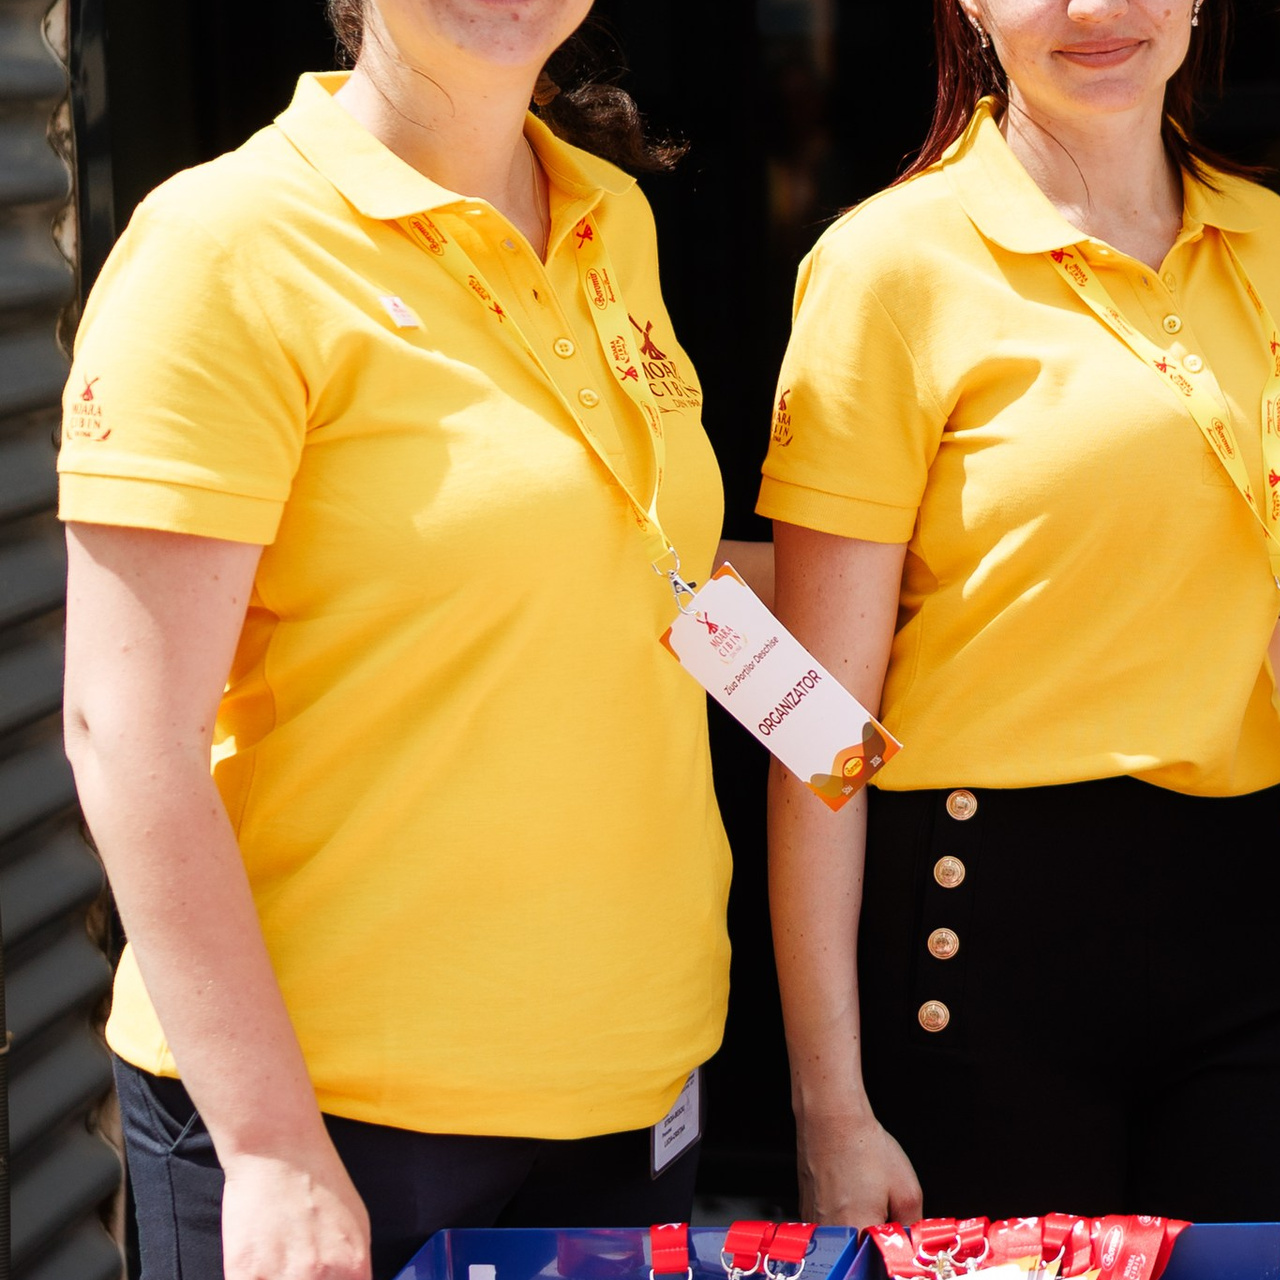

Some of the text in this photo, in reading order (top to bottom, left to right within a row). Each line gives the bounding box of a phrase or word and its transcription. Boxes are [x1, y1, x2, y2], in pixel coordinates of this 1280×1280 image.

[588, 272, 606, 307] Boromir
[642, 362, 685, 383] OAR
[1213, 420, 1234, 456] Boromir
[710, 624, 734, 648] MOARA
[718, 632, 741, 658] CIBIN
[723, 680, 739, 696] Ziua
[752, 636, 779, 664] Deschise
[758, 669, 822, 736] ORGANIZATOR
[1103, 1228, 1121, 1267] Boromir
